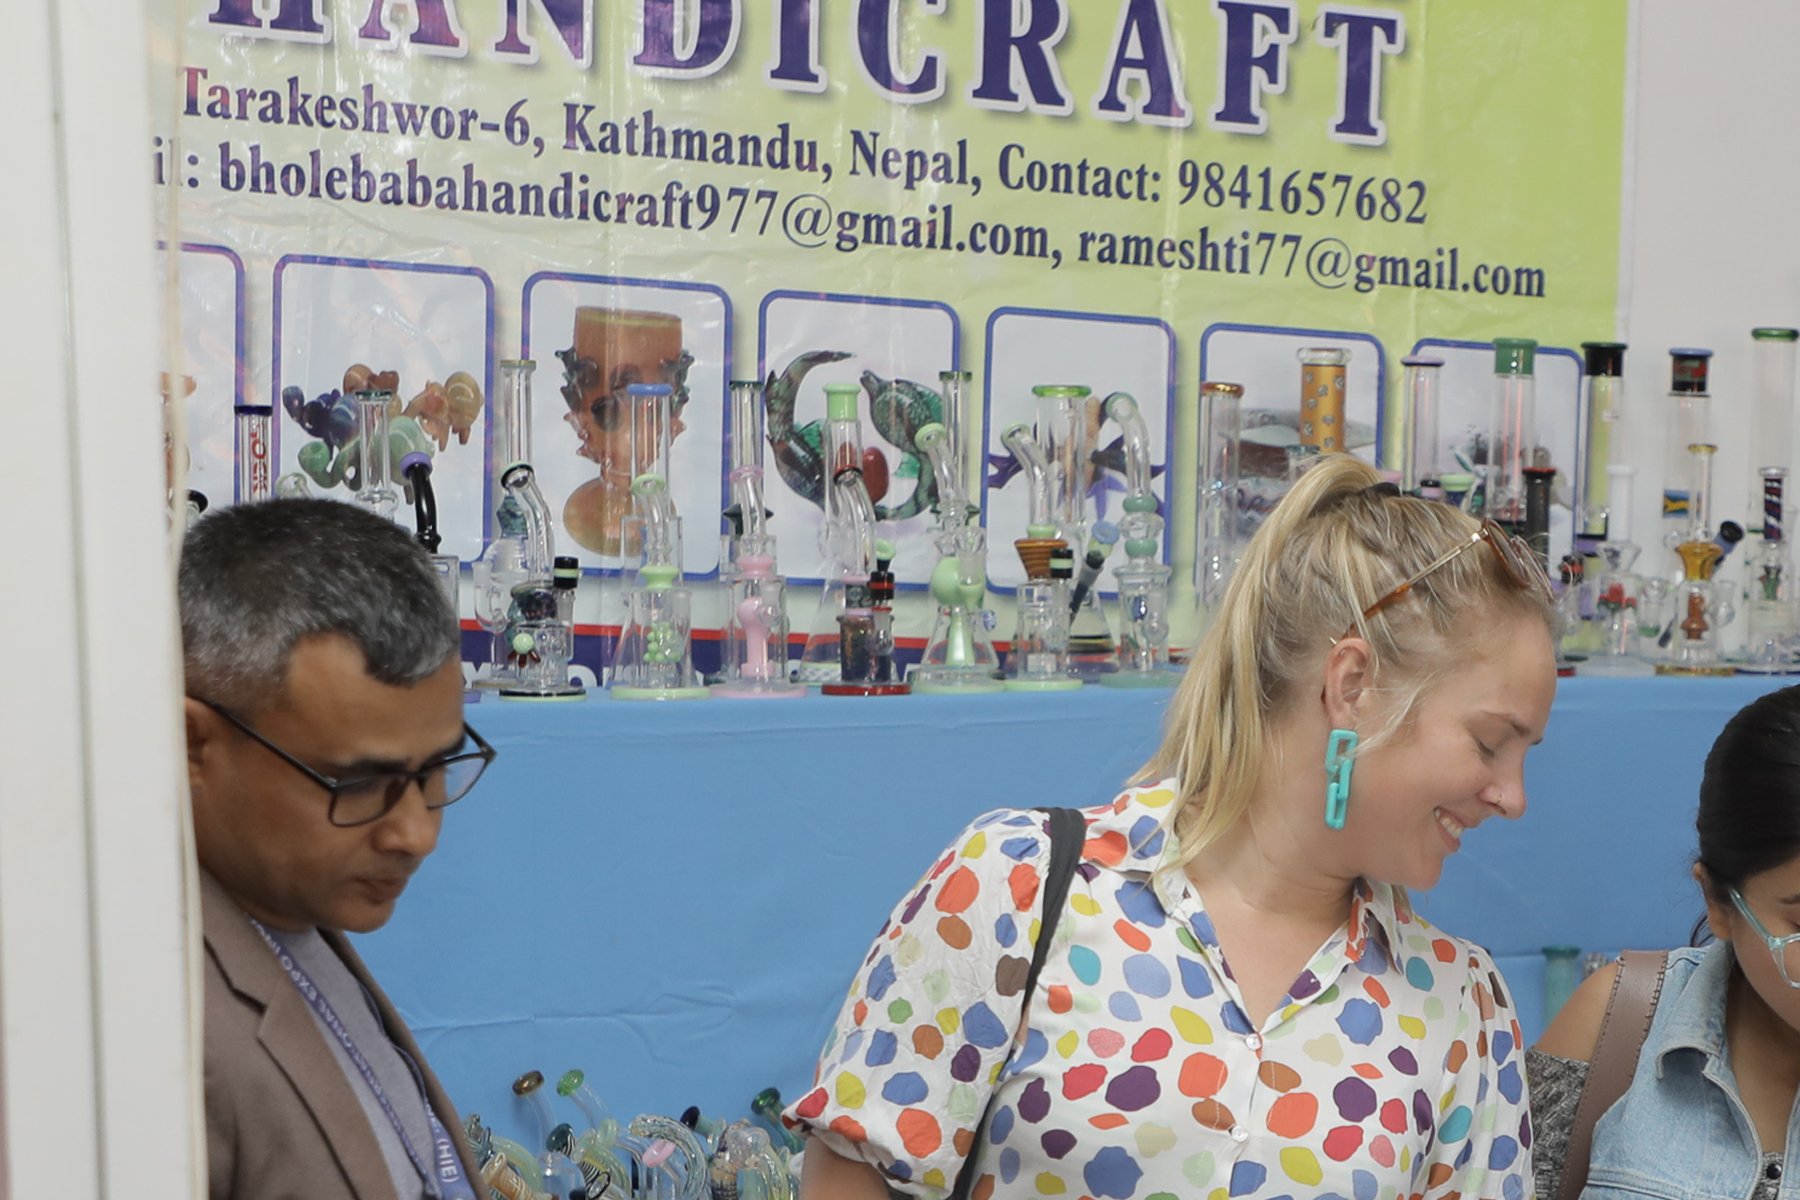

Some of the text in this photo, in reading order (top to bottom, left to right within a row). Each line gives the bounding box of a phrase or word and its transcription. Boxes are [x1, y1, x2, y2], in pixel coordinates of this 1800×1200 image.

[206, 0, 1400, 139] DICRAFT
[178, 66, 1428, 225] Tarakeshwor-6, Kathmandu, Nepal, Contact: 9841657682
[218, 140, 1063, 270] bholebabahandicraft977@gmail.com,
[1077, 226, 1546, 298] rameshti77@gmail.com
[435, 1138, 461, 1184] (HIE)
